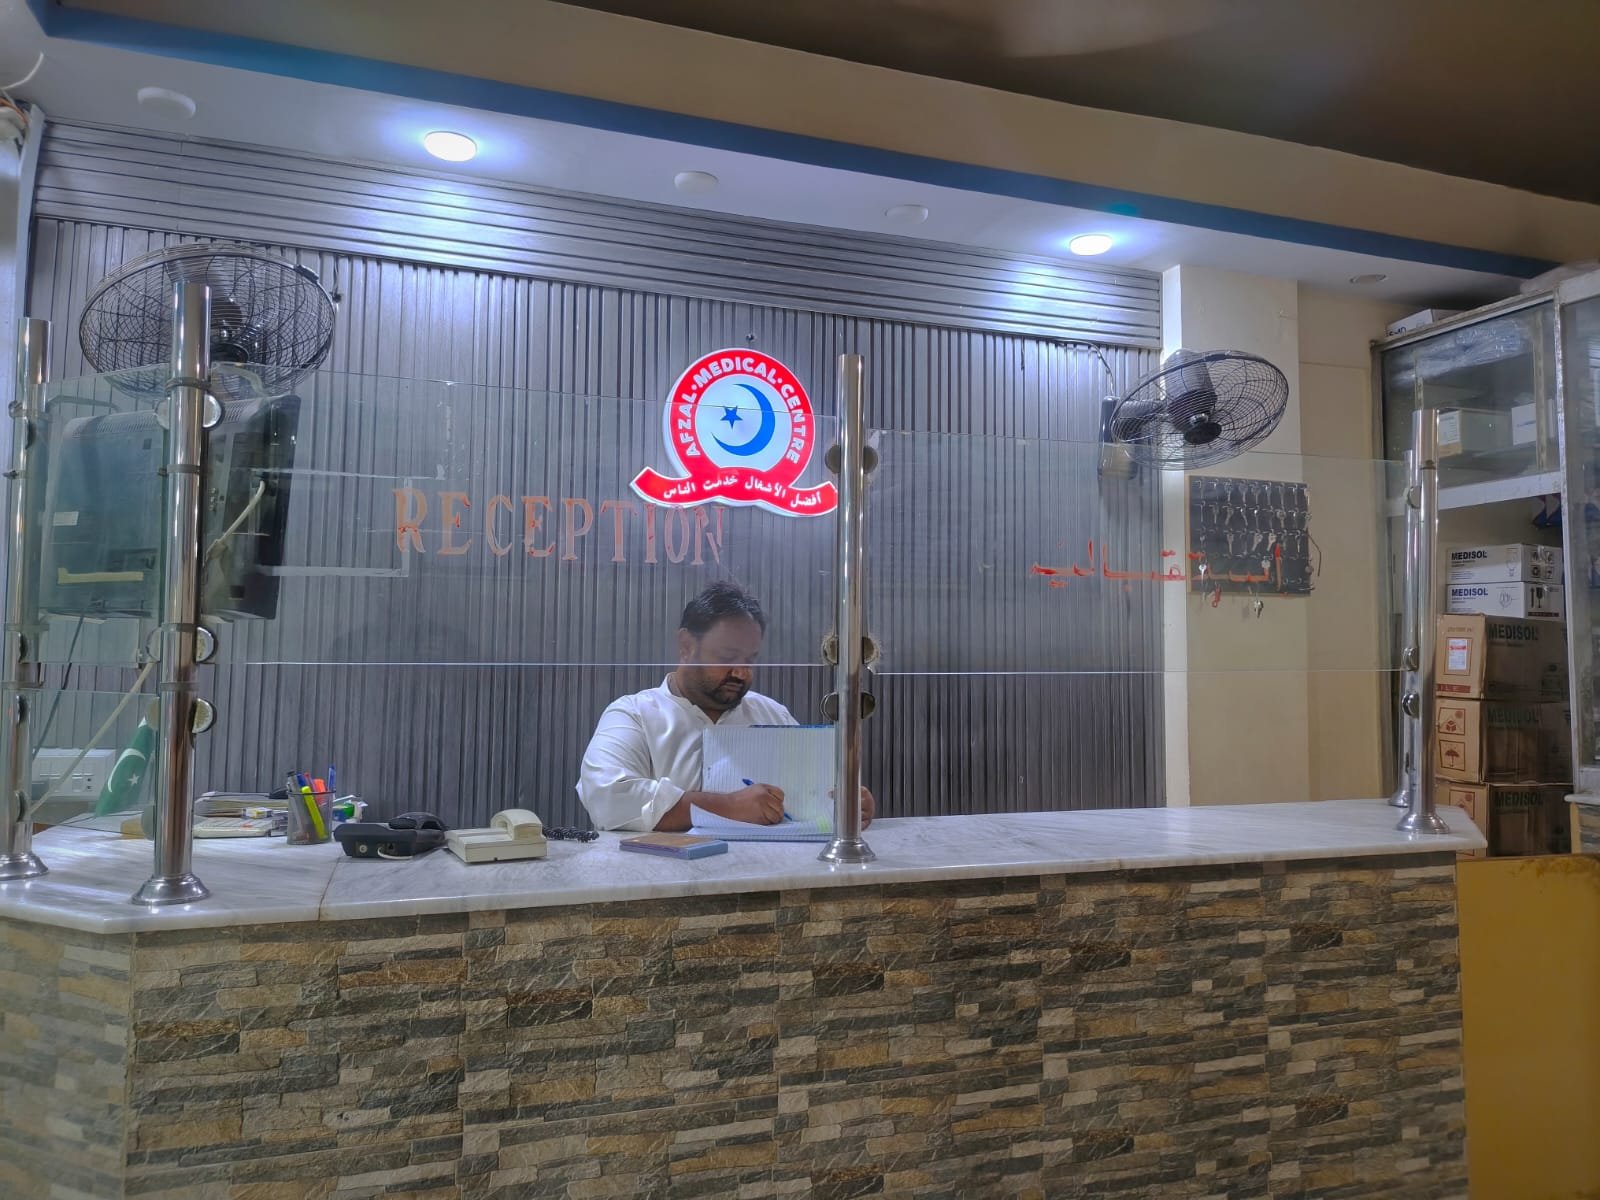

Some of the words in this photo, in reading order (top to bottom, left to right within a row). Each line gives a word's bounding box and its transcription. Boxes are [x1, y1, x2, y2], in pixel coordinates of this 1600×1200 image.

[678, 389, 701, 457] AFZAL
[693, 356, 777, 388] MEDICAL
[780, 383, 807, 464] CENTRE
[663, 481, 696, 499] الناس
[392, 488, 725, 566] RECEPTION
[1451, 550, 1488, 560] MEDISOL
[1451, 587, 1489, 597] MEDISOL
[1488, 624, 1538, 641] MEDISOL
